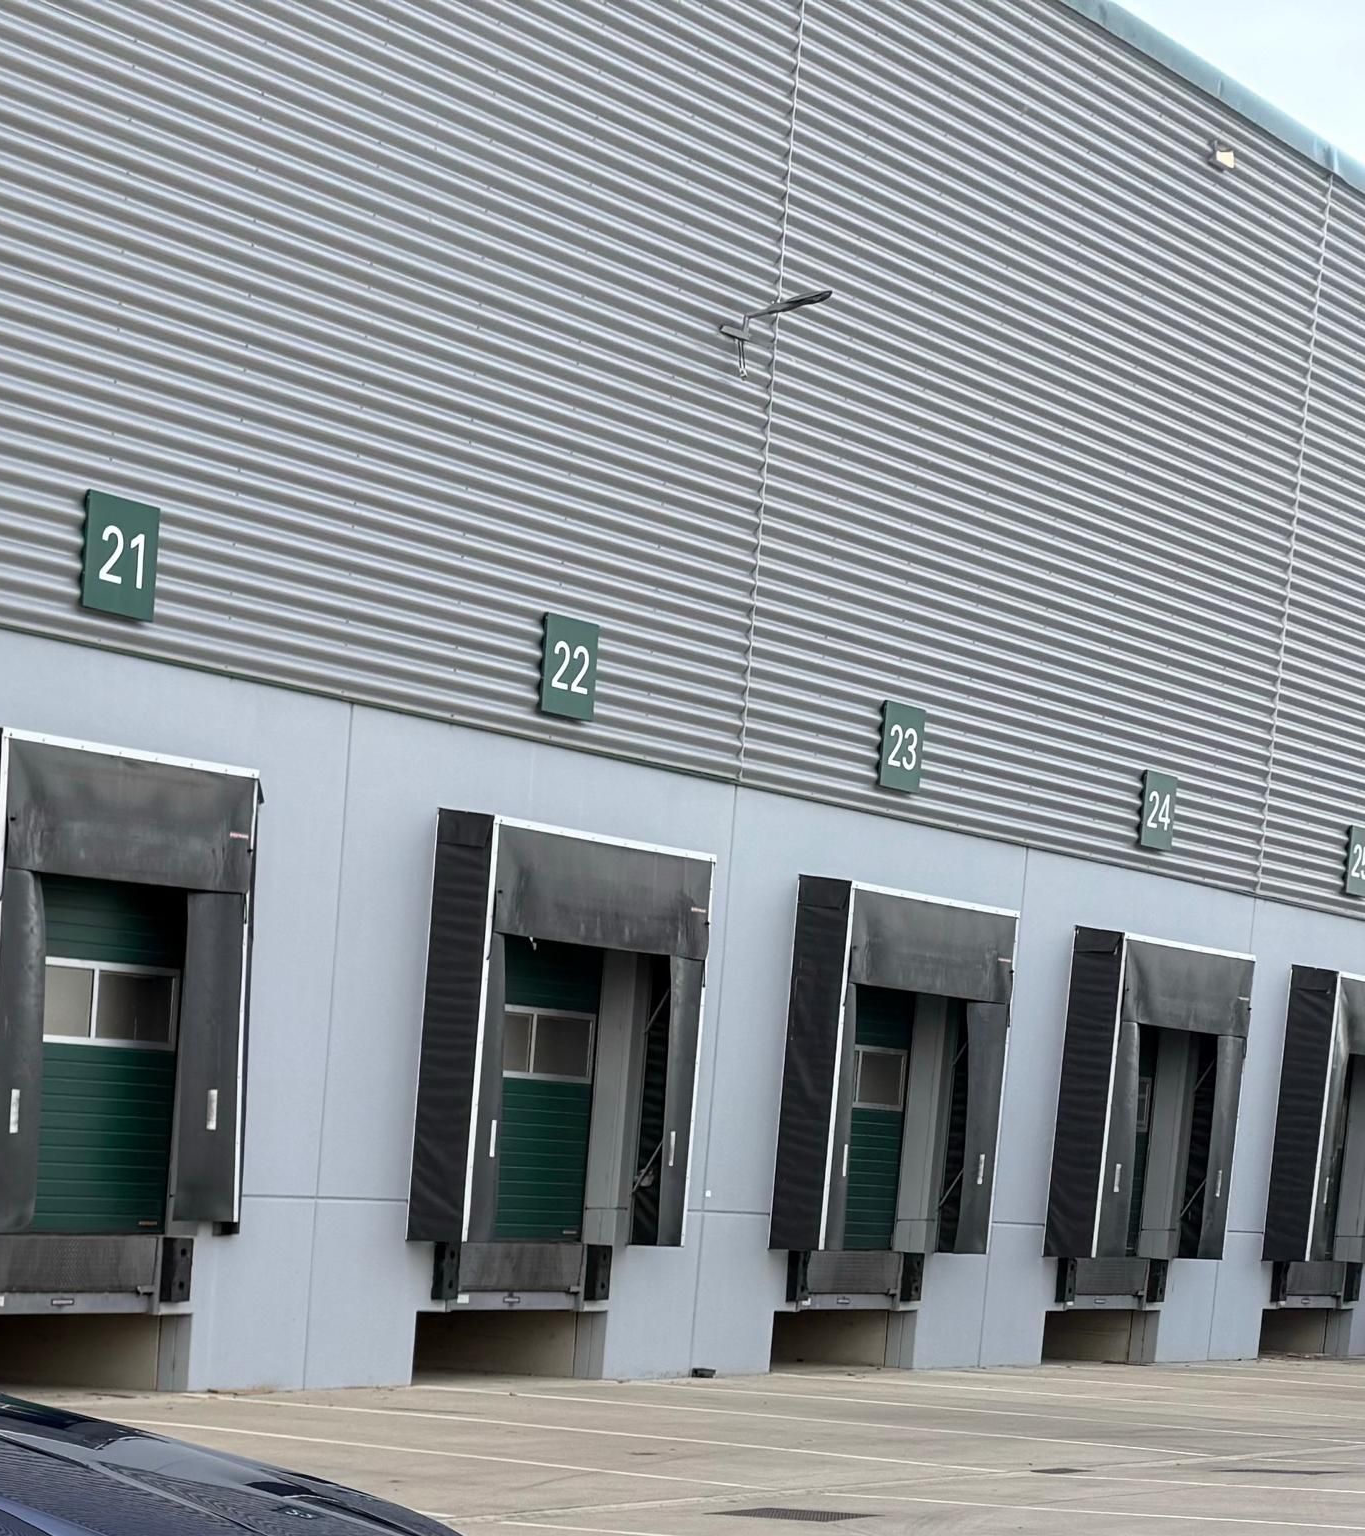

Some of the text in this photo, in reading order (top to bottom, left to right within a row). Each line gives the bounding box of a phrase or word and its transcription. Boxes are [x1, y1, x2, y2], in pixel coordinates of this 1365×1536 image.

[99, 525, 145, 589] 21
[551, 640, 589, 695] 22
[888, 724, 917, 770] 23
[1147, 791, 1170, 831] 24
